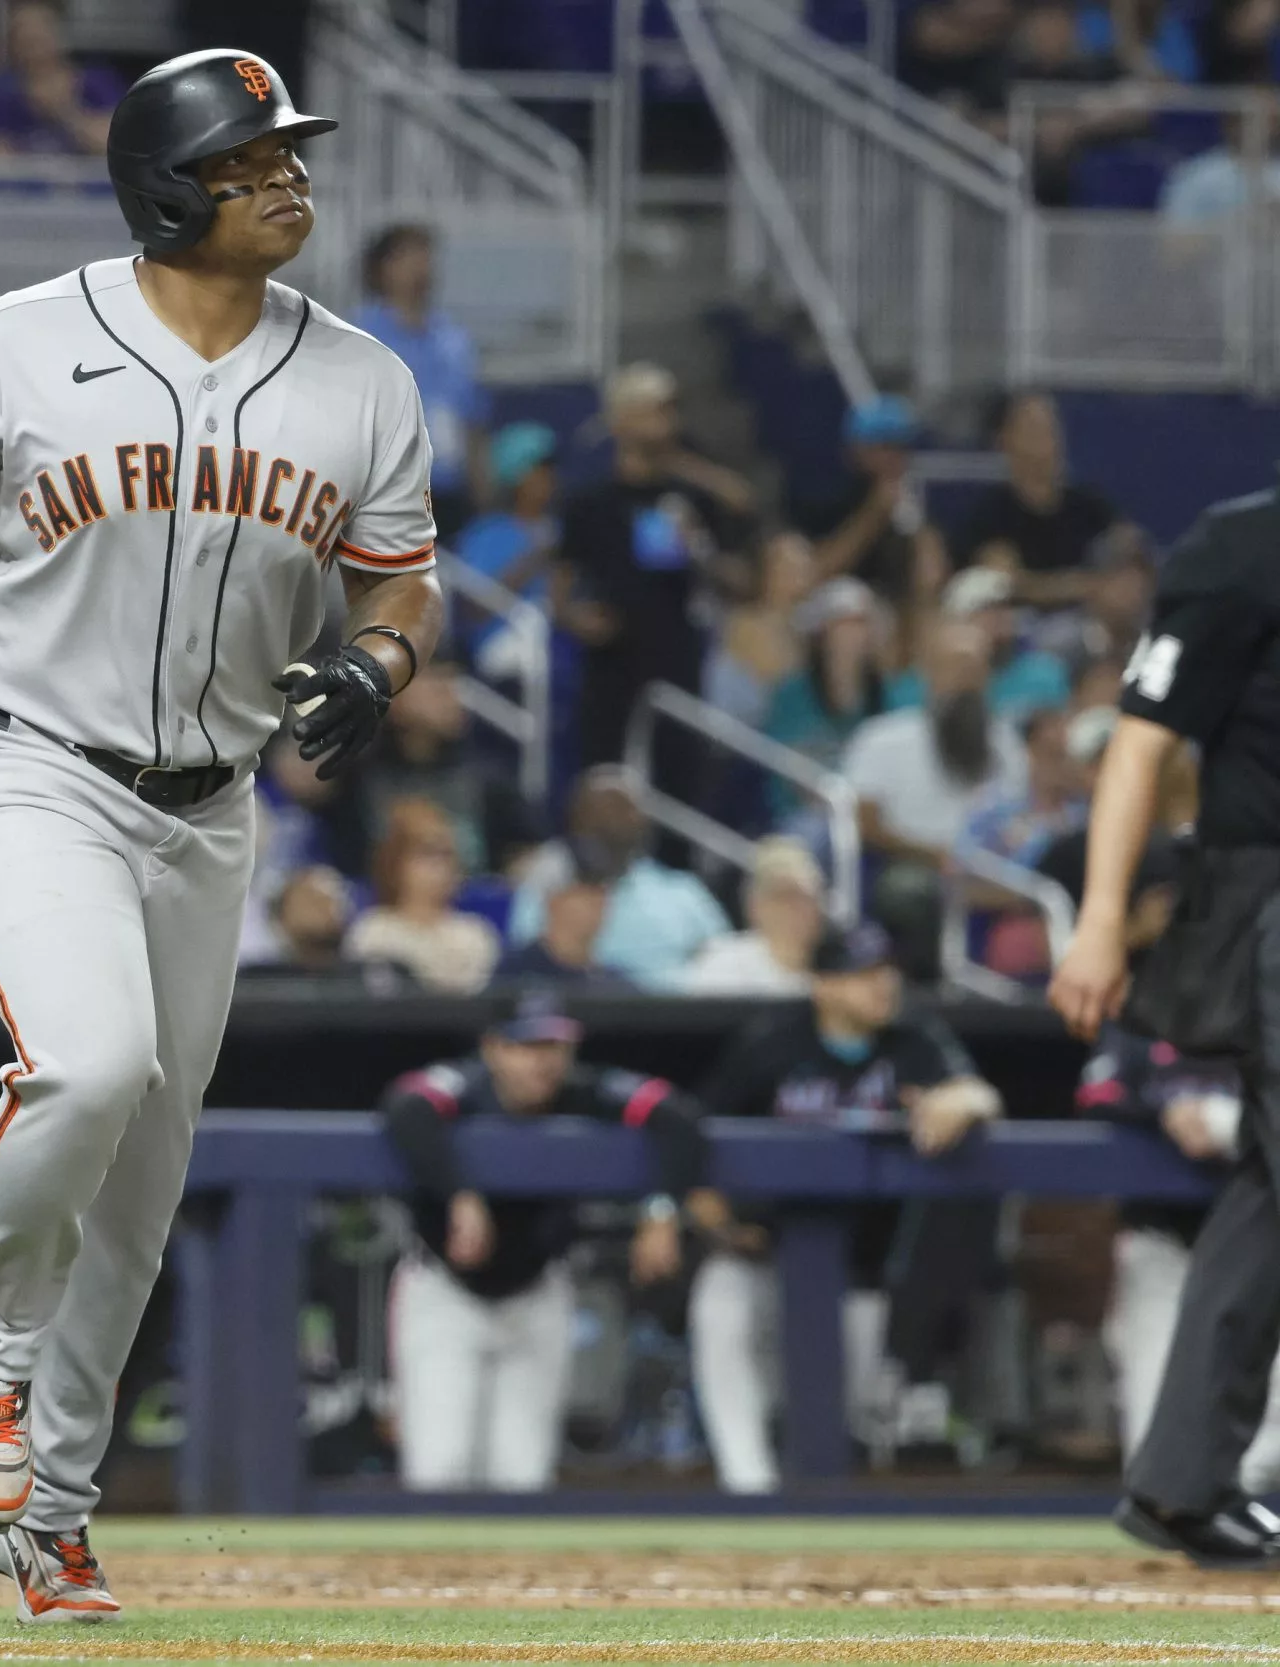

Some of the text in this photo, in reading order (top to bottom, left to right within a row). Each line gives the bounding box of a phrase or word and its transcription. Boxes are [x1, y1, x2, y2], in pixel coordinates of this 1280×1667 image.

[234, 59, 271, 102] SF
[20, 442, 351, 574] SAN FRANCISC
